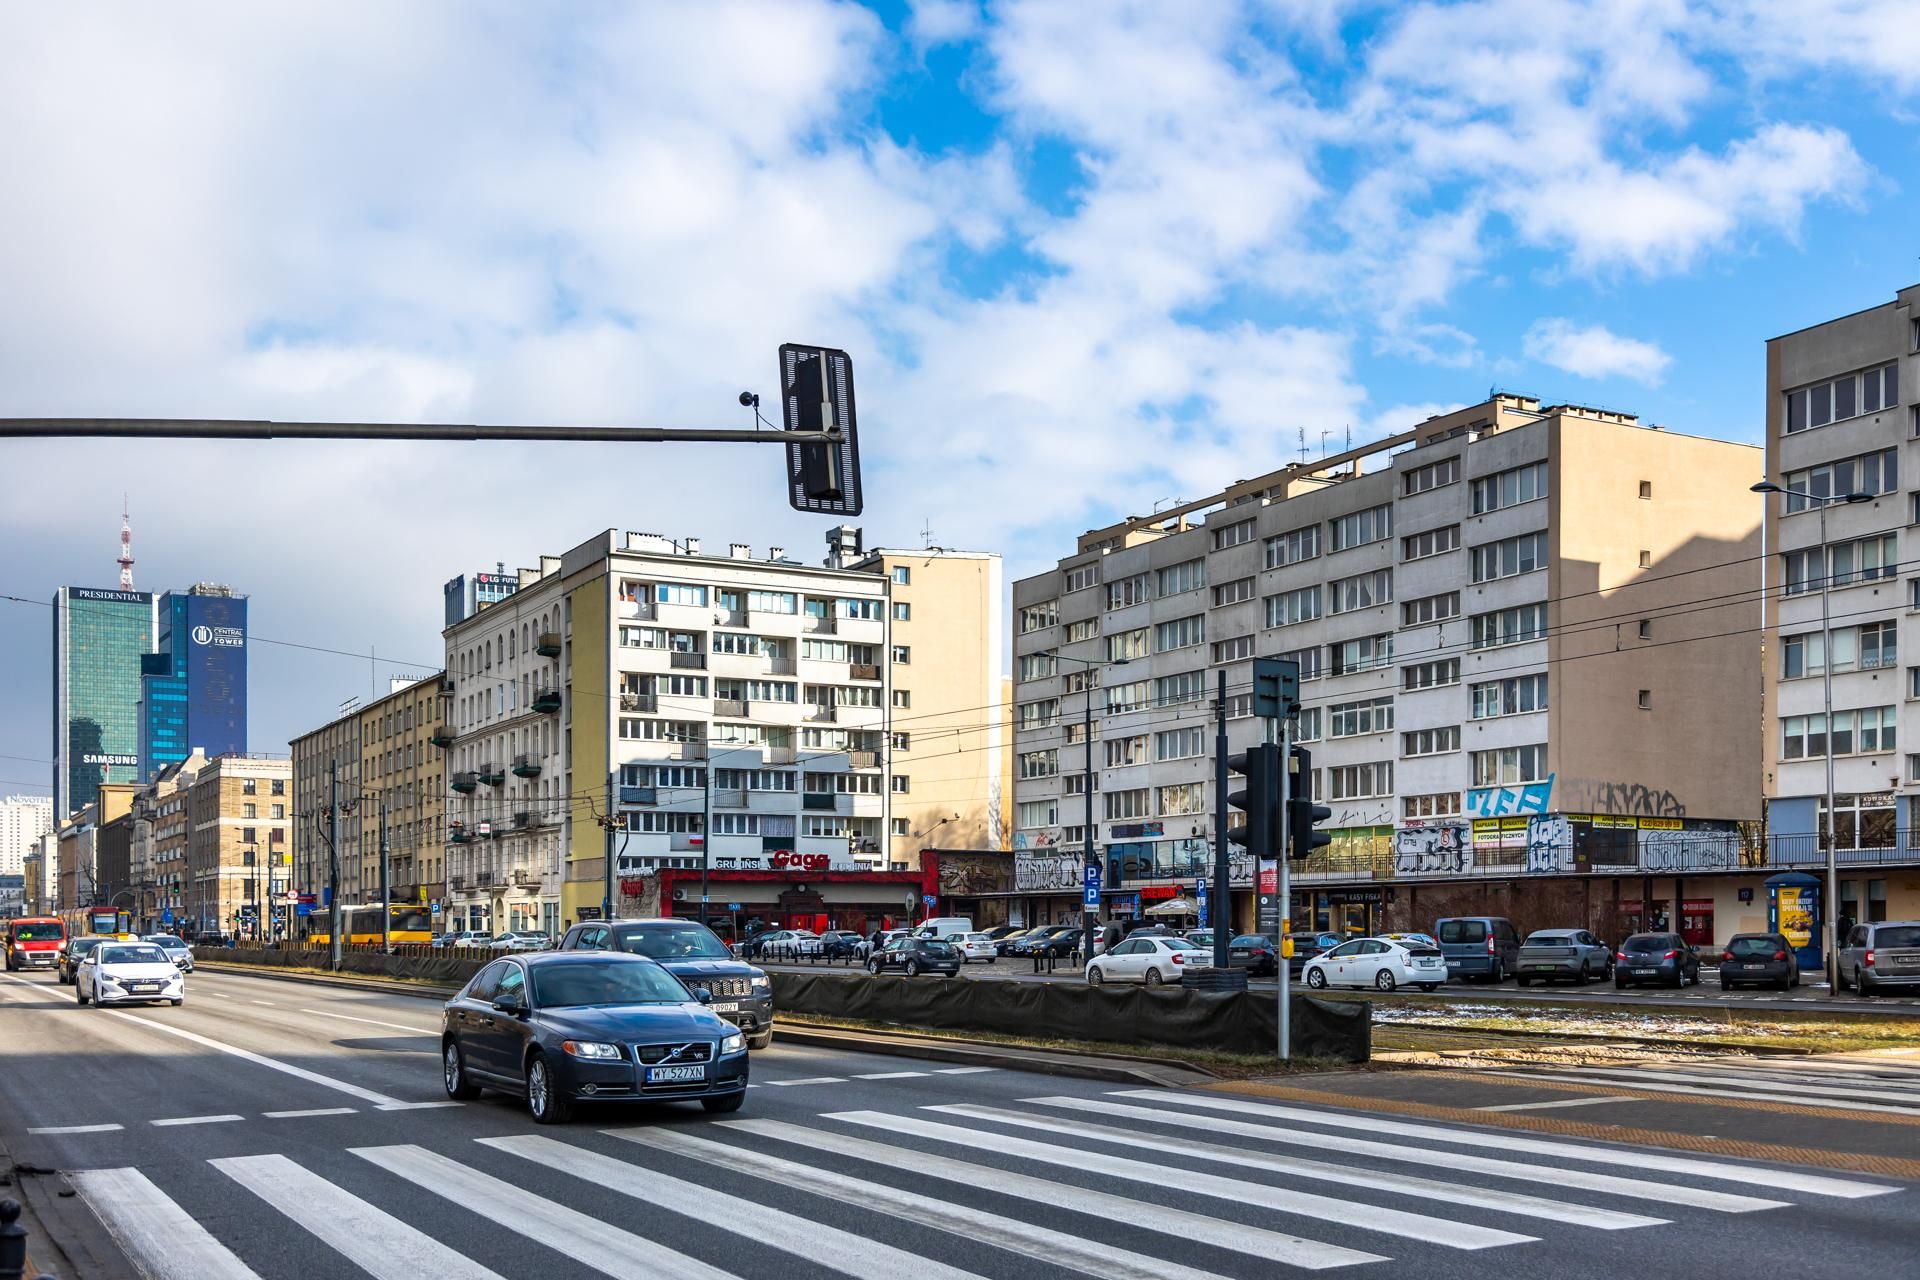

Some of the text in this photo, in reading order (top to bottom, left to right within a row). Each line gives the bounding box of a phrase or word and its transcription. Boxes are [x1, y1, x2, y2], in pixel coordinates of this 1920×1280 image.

[80, 590, 142, 602] PRESIDENTIAL
[83, 754, 138, 764] SAMSUNG
[10, 796, 49, 804] NOVOTEL
[774, 850, 828, 870] Gaga
[1088, 868, 1096, 880] P
[1141, 886, 1176, 898] EREWAN
[1198, 880, 1204, 892] P
[1088, 888, 1096, 902] P
[654, 1066, 702, 1079] WY 527XN
